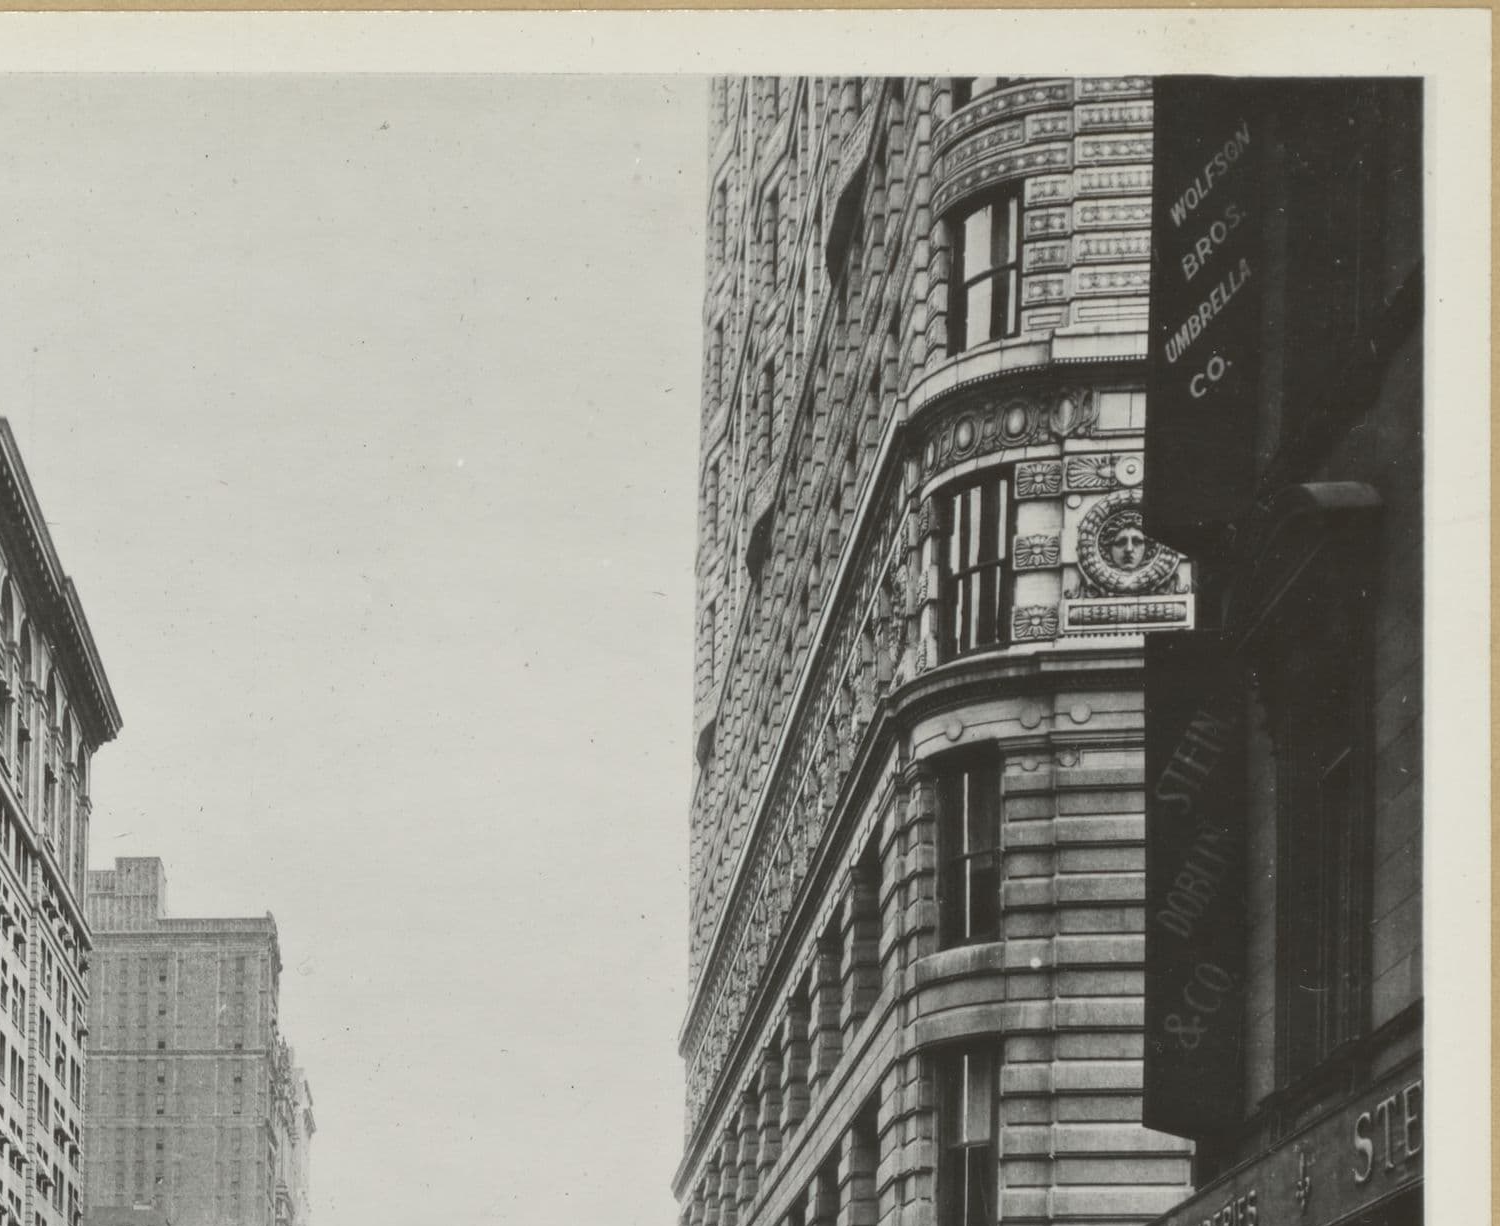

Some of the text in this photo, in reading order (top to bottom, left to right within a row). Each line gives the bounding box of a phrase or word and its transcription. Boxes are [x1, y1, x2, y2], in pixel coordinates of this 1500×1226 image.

[1169, 126, 1251, 228] WOLFSON
[1181, 205, 1246, 281] BROS.
[1164, 258, 1253, 364] UMBRELLA
[1189, 355, 1232, 398] CO.
